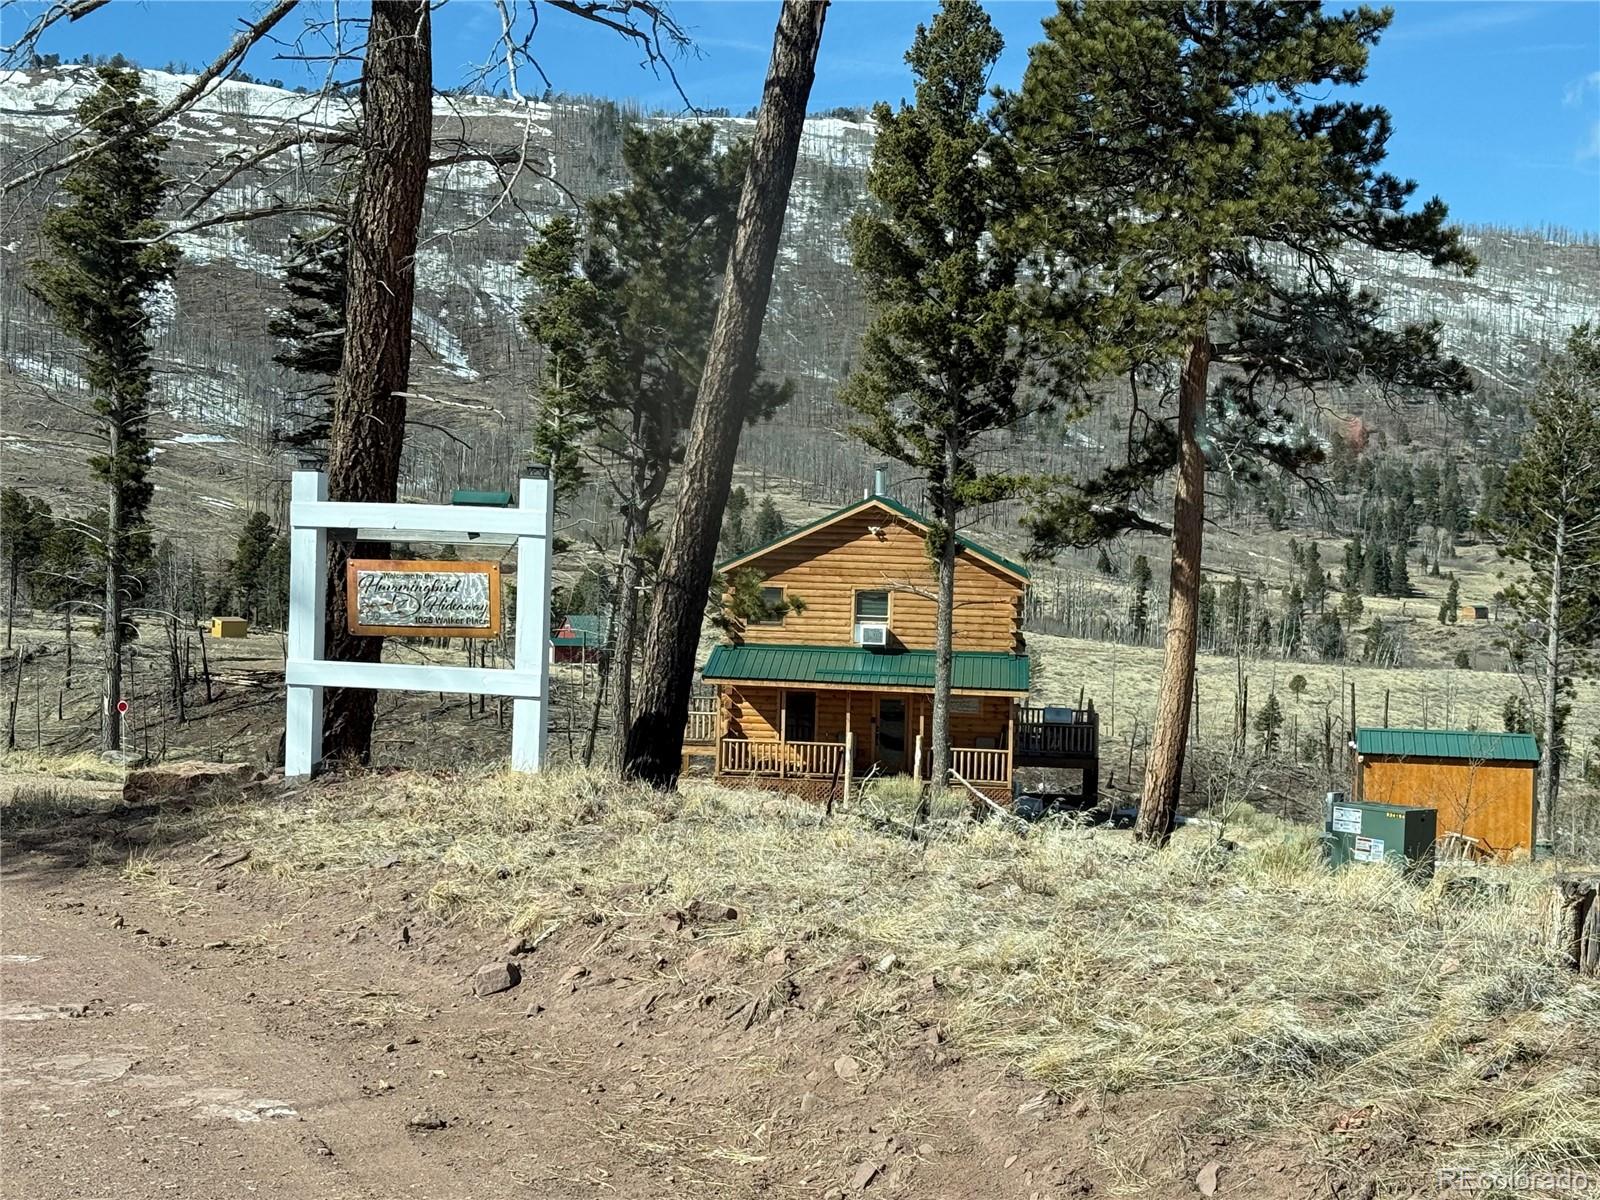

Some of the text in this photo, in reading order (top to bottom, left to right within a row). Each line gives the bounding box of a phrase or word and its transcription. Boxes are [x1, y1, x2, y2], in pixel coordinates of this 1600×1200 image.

[358, 574, 462, 599] Hummingbird
[423, 595, 488, 618] Hideaway
[435, 616, 464, 625] Walker
[466, 616, 489, 625] Place
